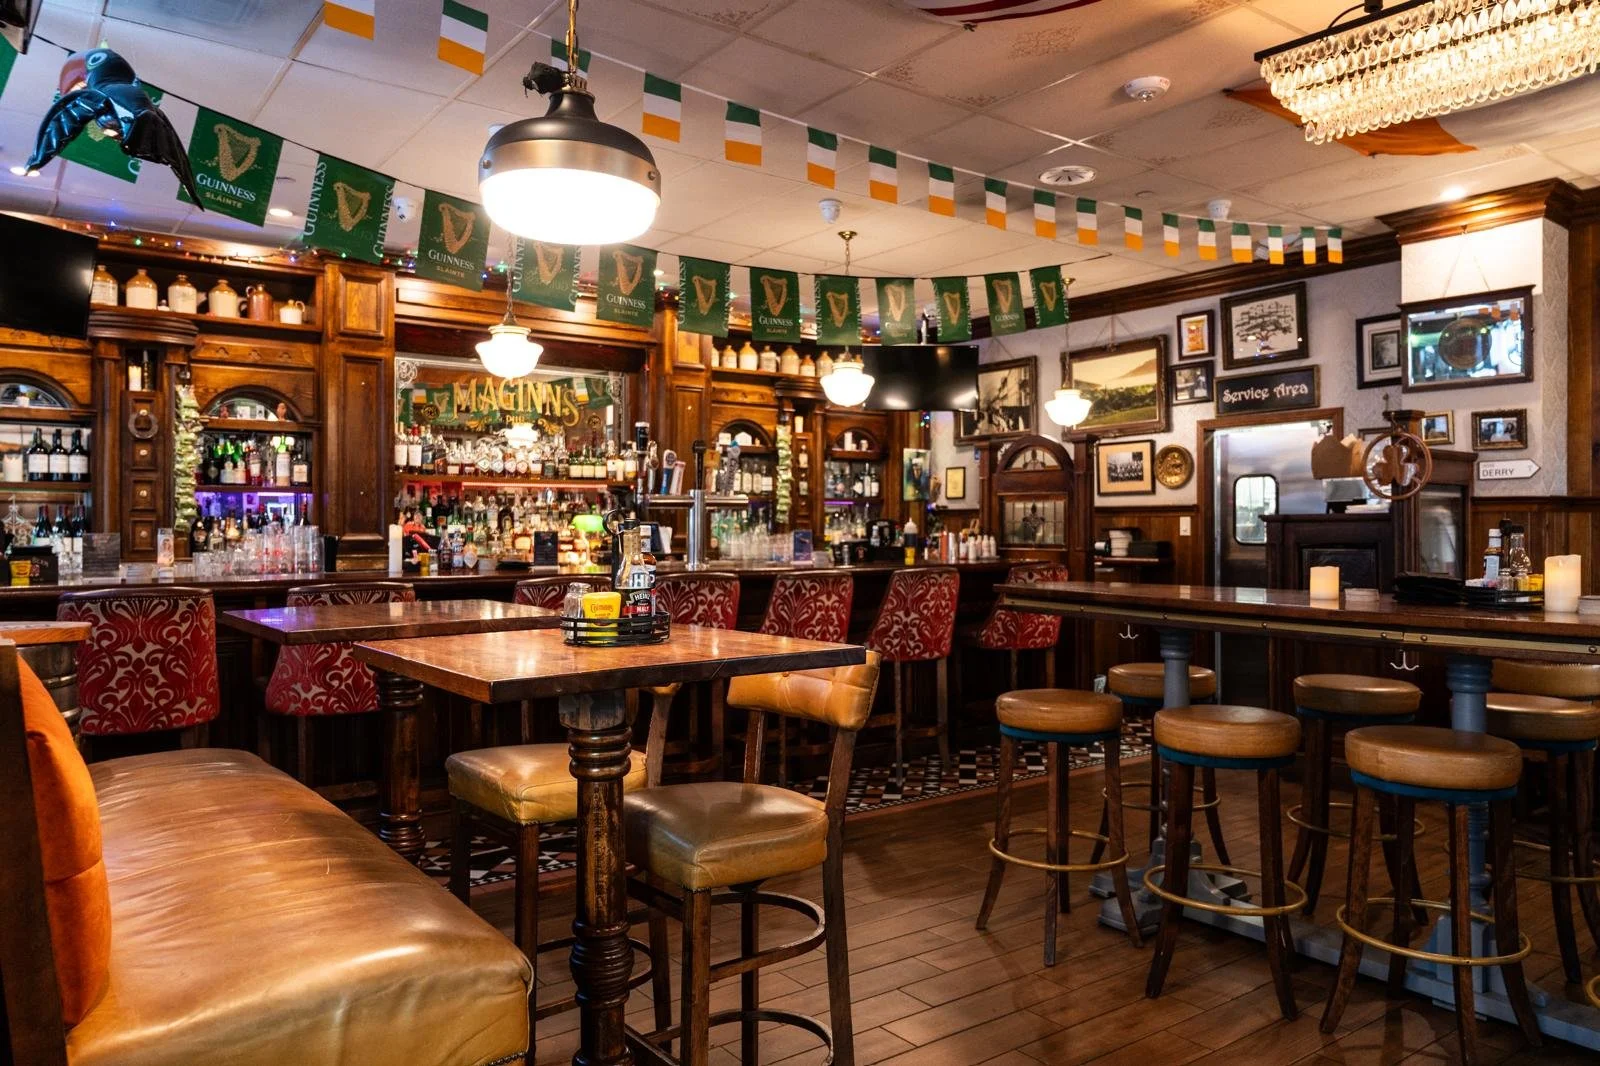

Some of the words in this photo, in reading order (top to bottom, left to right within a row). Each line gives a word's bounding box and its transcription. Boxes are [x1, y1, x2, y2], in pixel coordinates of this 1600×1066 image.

[196, 173, 257, 202] GUINNESS
[303, 162, 327, 236] GUINNESS
[428, 249, 475, 271] GUINNESS
[606, 293, 647, 310] GUINNESS
[759, 316, 794, 327] GUINNESS
[1223, 387, 1270, 404] Service
[1273, 383, 1308, 398] Area
[1482, 468, 1514, 477] DERRY
[634, 592, 651, 601] HEINZ
